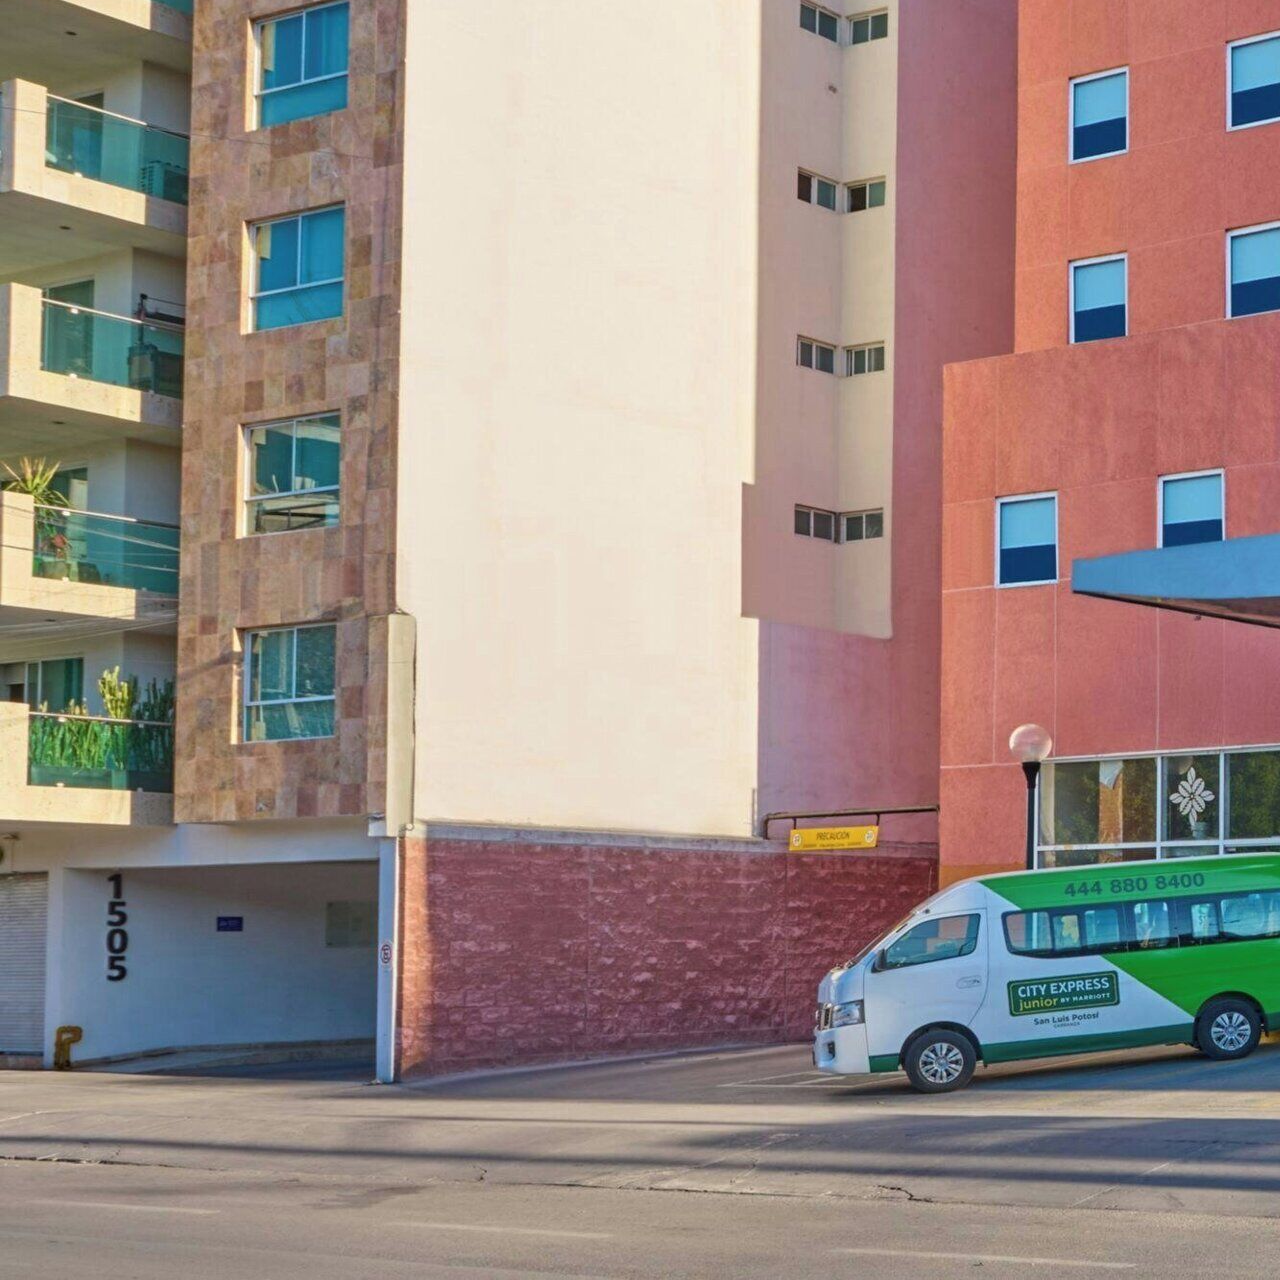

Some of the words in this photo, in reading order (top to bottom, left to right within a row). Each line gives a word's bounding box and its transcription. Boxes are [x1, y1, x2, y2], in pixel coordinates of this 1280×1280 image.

[1064, 880, 1103, 897] 444
[1110, 877, 1148, 894] 880
[1155, 873, 1205, 890] 8400
[106, 873, 128, 982] 1505
[1018, 983, 1046, 998] CITY
[1050, 977, 1110, 994] EXPRESS
[1019, 996, 1059, 1011] junior
[1072, 992, 1111, 1003] MARRIOTT
[1034, 1017, 1050, 1026] San
[1052, 1015, 1070, 1024] Luis
